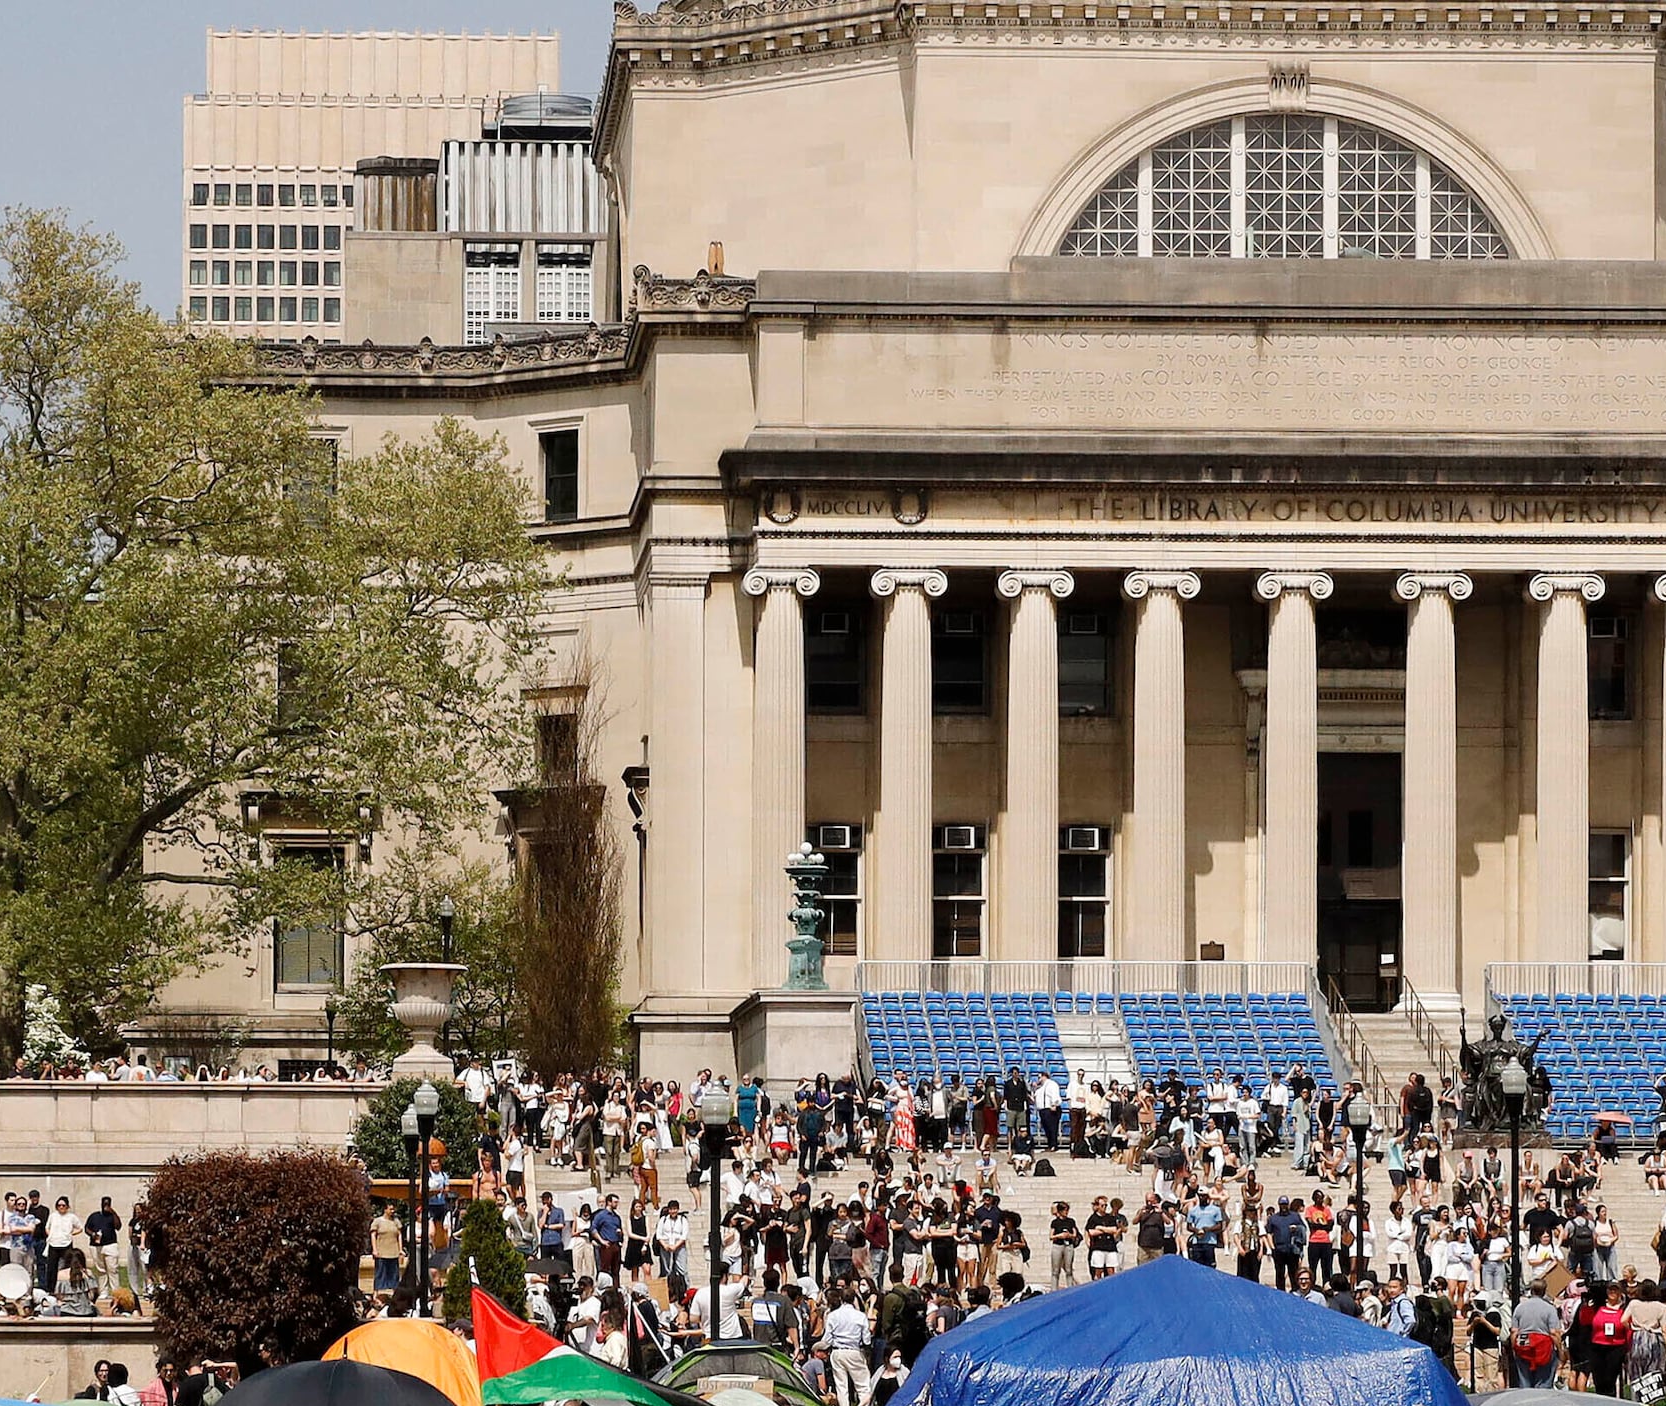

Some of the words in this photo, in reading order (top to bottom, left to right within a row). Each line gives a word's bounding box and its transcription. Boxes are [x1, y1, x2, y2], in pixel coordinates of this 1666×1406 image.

[1020, 332, 1088, 349] KINGS
[1101, 333, 1201, 350] COLLEGE
[1215, 333, 1319, 350] FOUNDED
[1335, 334, 1355, 351] IN
[1368, 334, 1414, 351] THE
[1427, 334, 1535, 351] PROVINCE
[1547, 335, 1575, 352] OF
[1587, 335, 1636, 352] NEW
[807, 501, 884, 515] MDCCLIV
[1071, 499, 1124, 520] THE
[1141, 499, 1258, 521] LIBRARY
[1272, 500, 1310, 521] OF
[1326, 500, 1474, 522] COLUMBIA
[1489, 501, 1662, 523] UNIVERSITY
